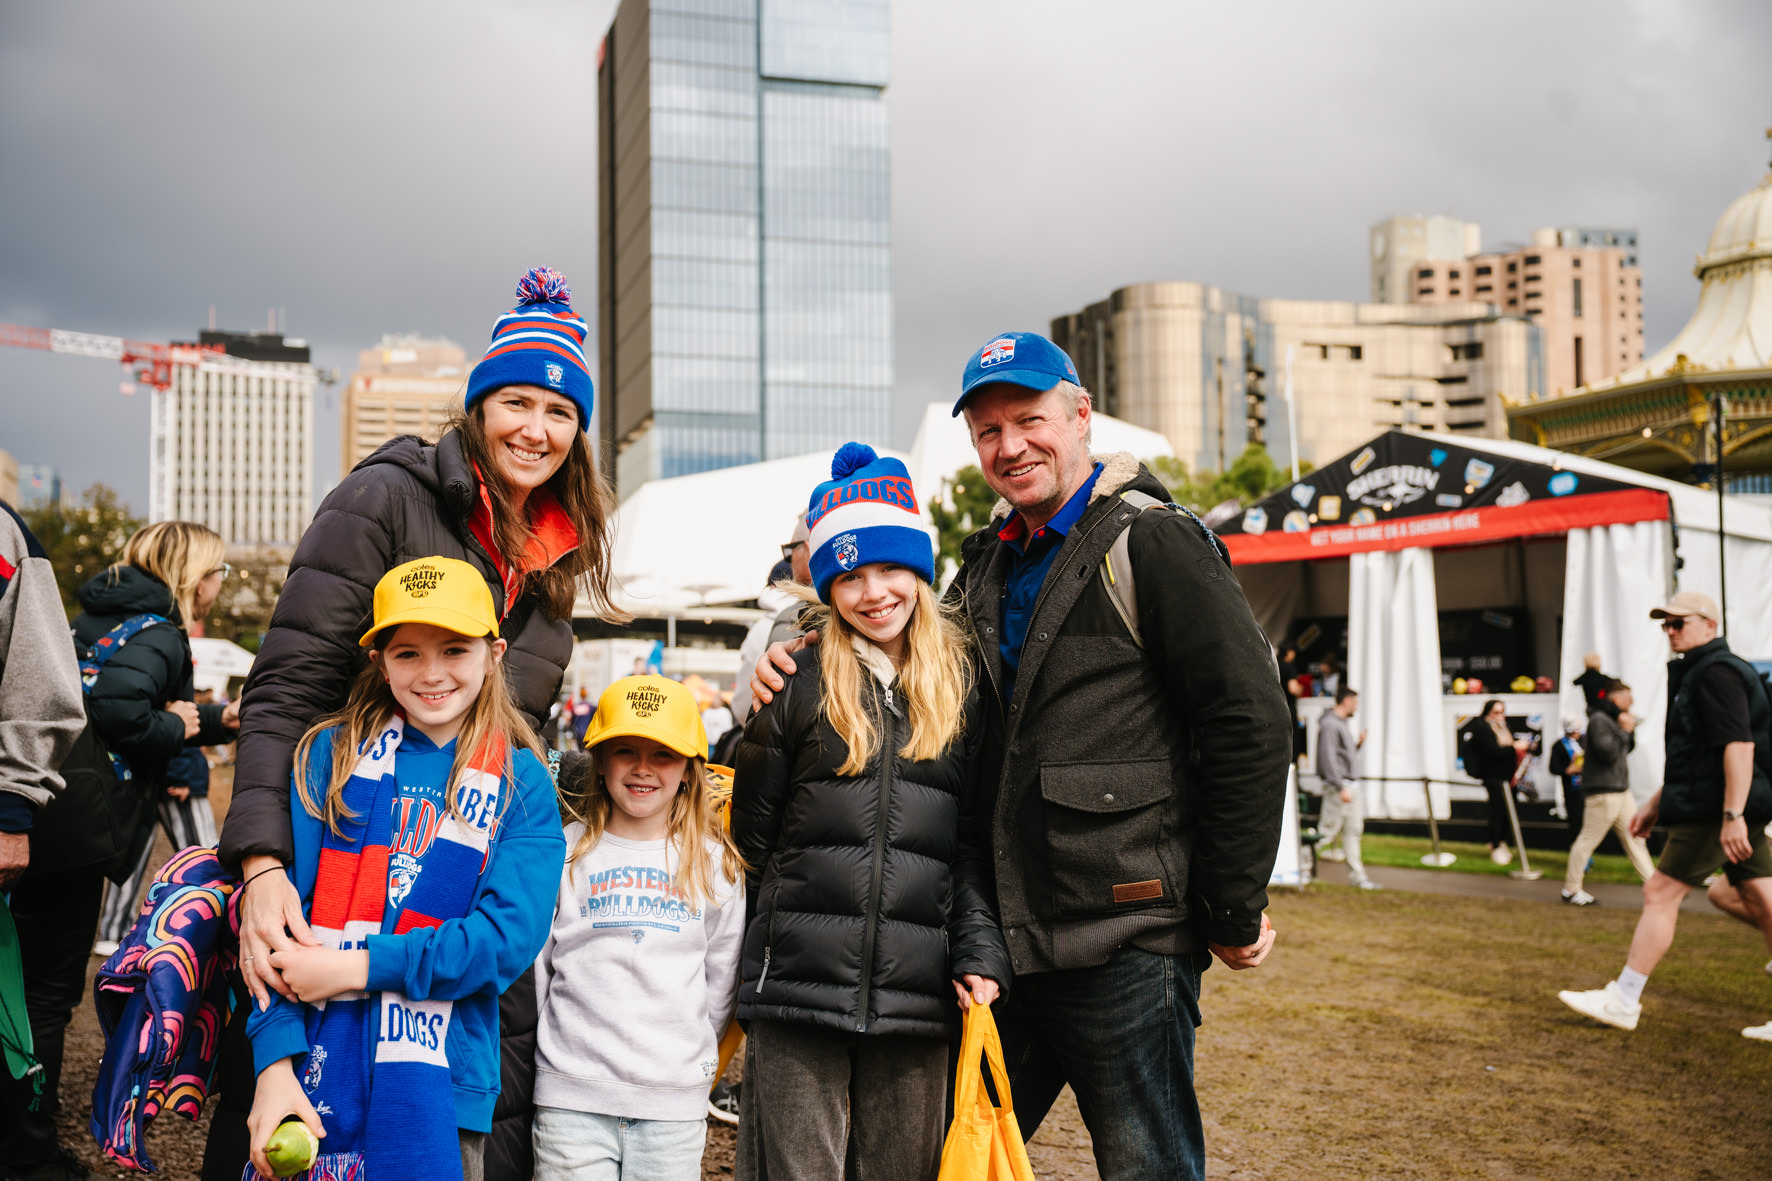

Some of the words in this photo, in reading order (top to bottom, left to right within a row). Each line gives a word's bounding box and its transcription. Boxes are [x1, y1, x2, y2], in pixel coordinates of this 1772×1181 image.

[1346, 465, 1440, 500] SHERRIN
[806, 479, 914, 530] ULLDOGS
[1310, 530, 1329, 546] GET
[1329, 528, 1354, 544] YOUR
[1356, 525, 1383, 541] NAME
[1384, 523, 1398, 539] ON
[1400, 522, 1407, 537] A
[1408, 517, 1451, 536] SHERRIN
[1452, 513, 1480, 530] HERE
[410, 564, 435, 572] coles
[400, 571, 445, 585] HEALTHY
[405, 580, 437, 592] KICKS
[637, 685, 660, 693] coles
[626, 691, 667, 704] HEALTHY
[631, 701, 660, 711] KICKS
[403, 786, 446, 797] WESTER
[588, 894, 690, 922] BULLDOGS
